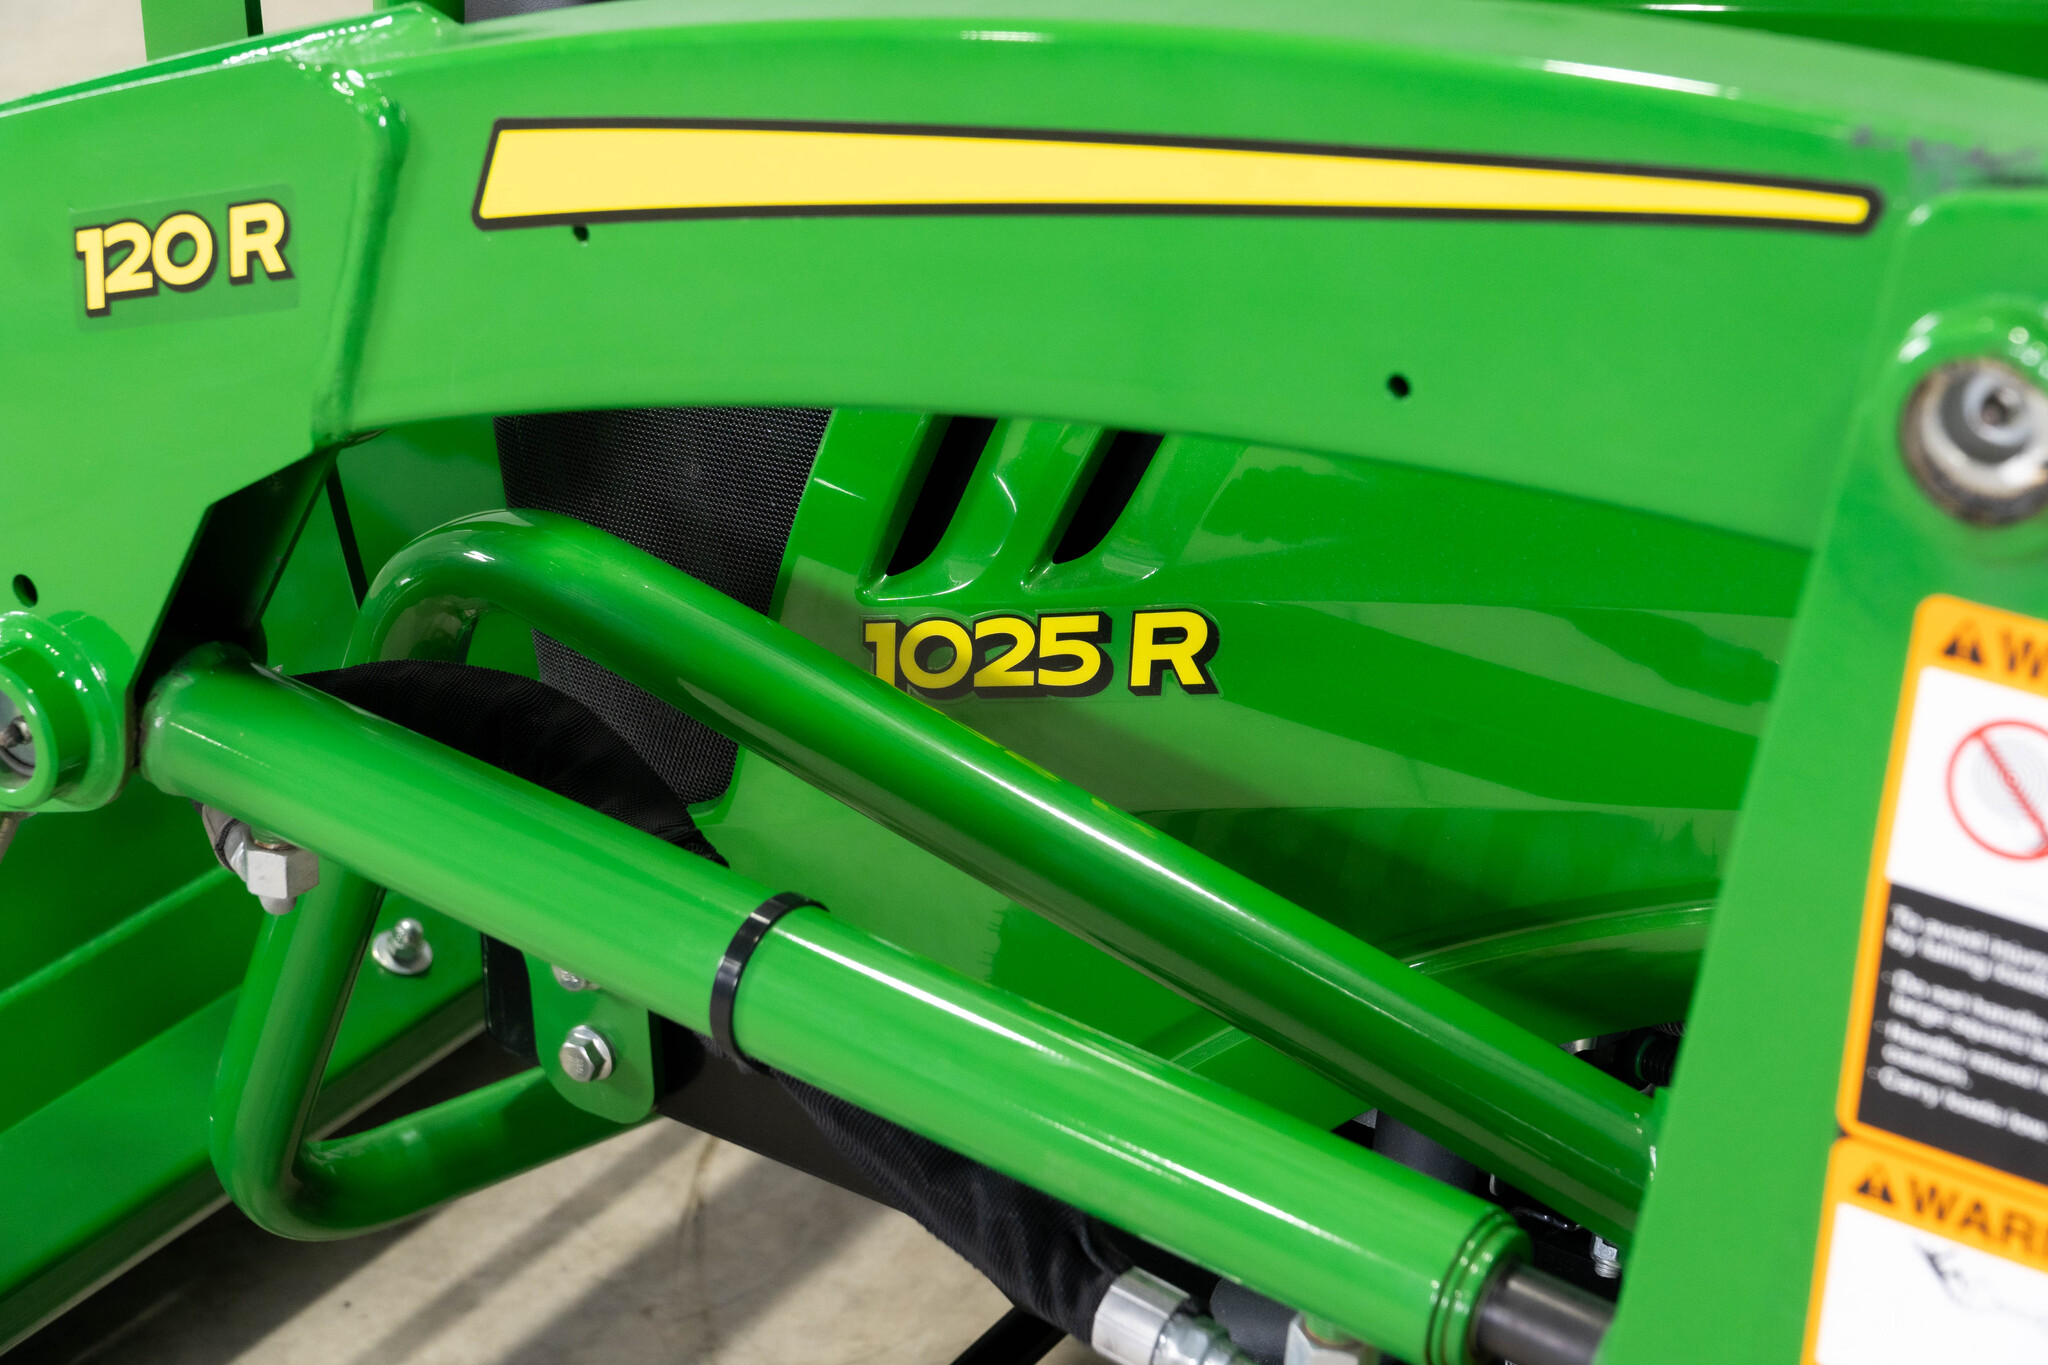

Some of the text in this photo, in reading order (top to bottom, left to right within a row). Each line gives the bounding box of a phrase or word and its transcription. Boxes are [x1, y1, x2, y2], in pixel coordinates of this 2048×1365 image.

[75, 199, 295, 318] 120 R
[863, 608, 1219, 698] 1025 R
[1907, 1173, 2048, 1257] WAR
